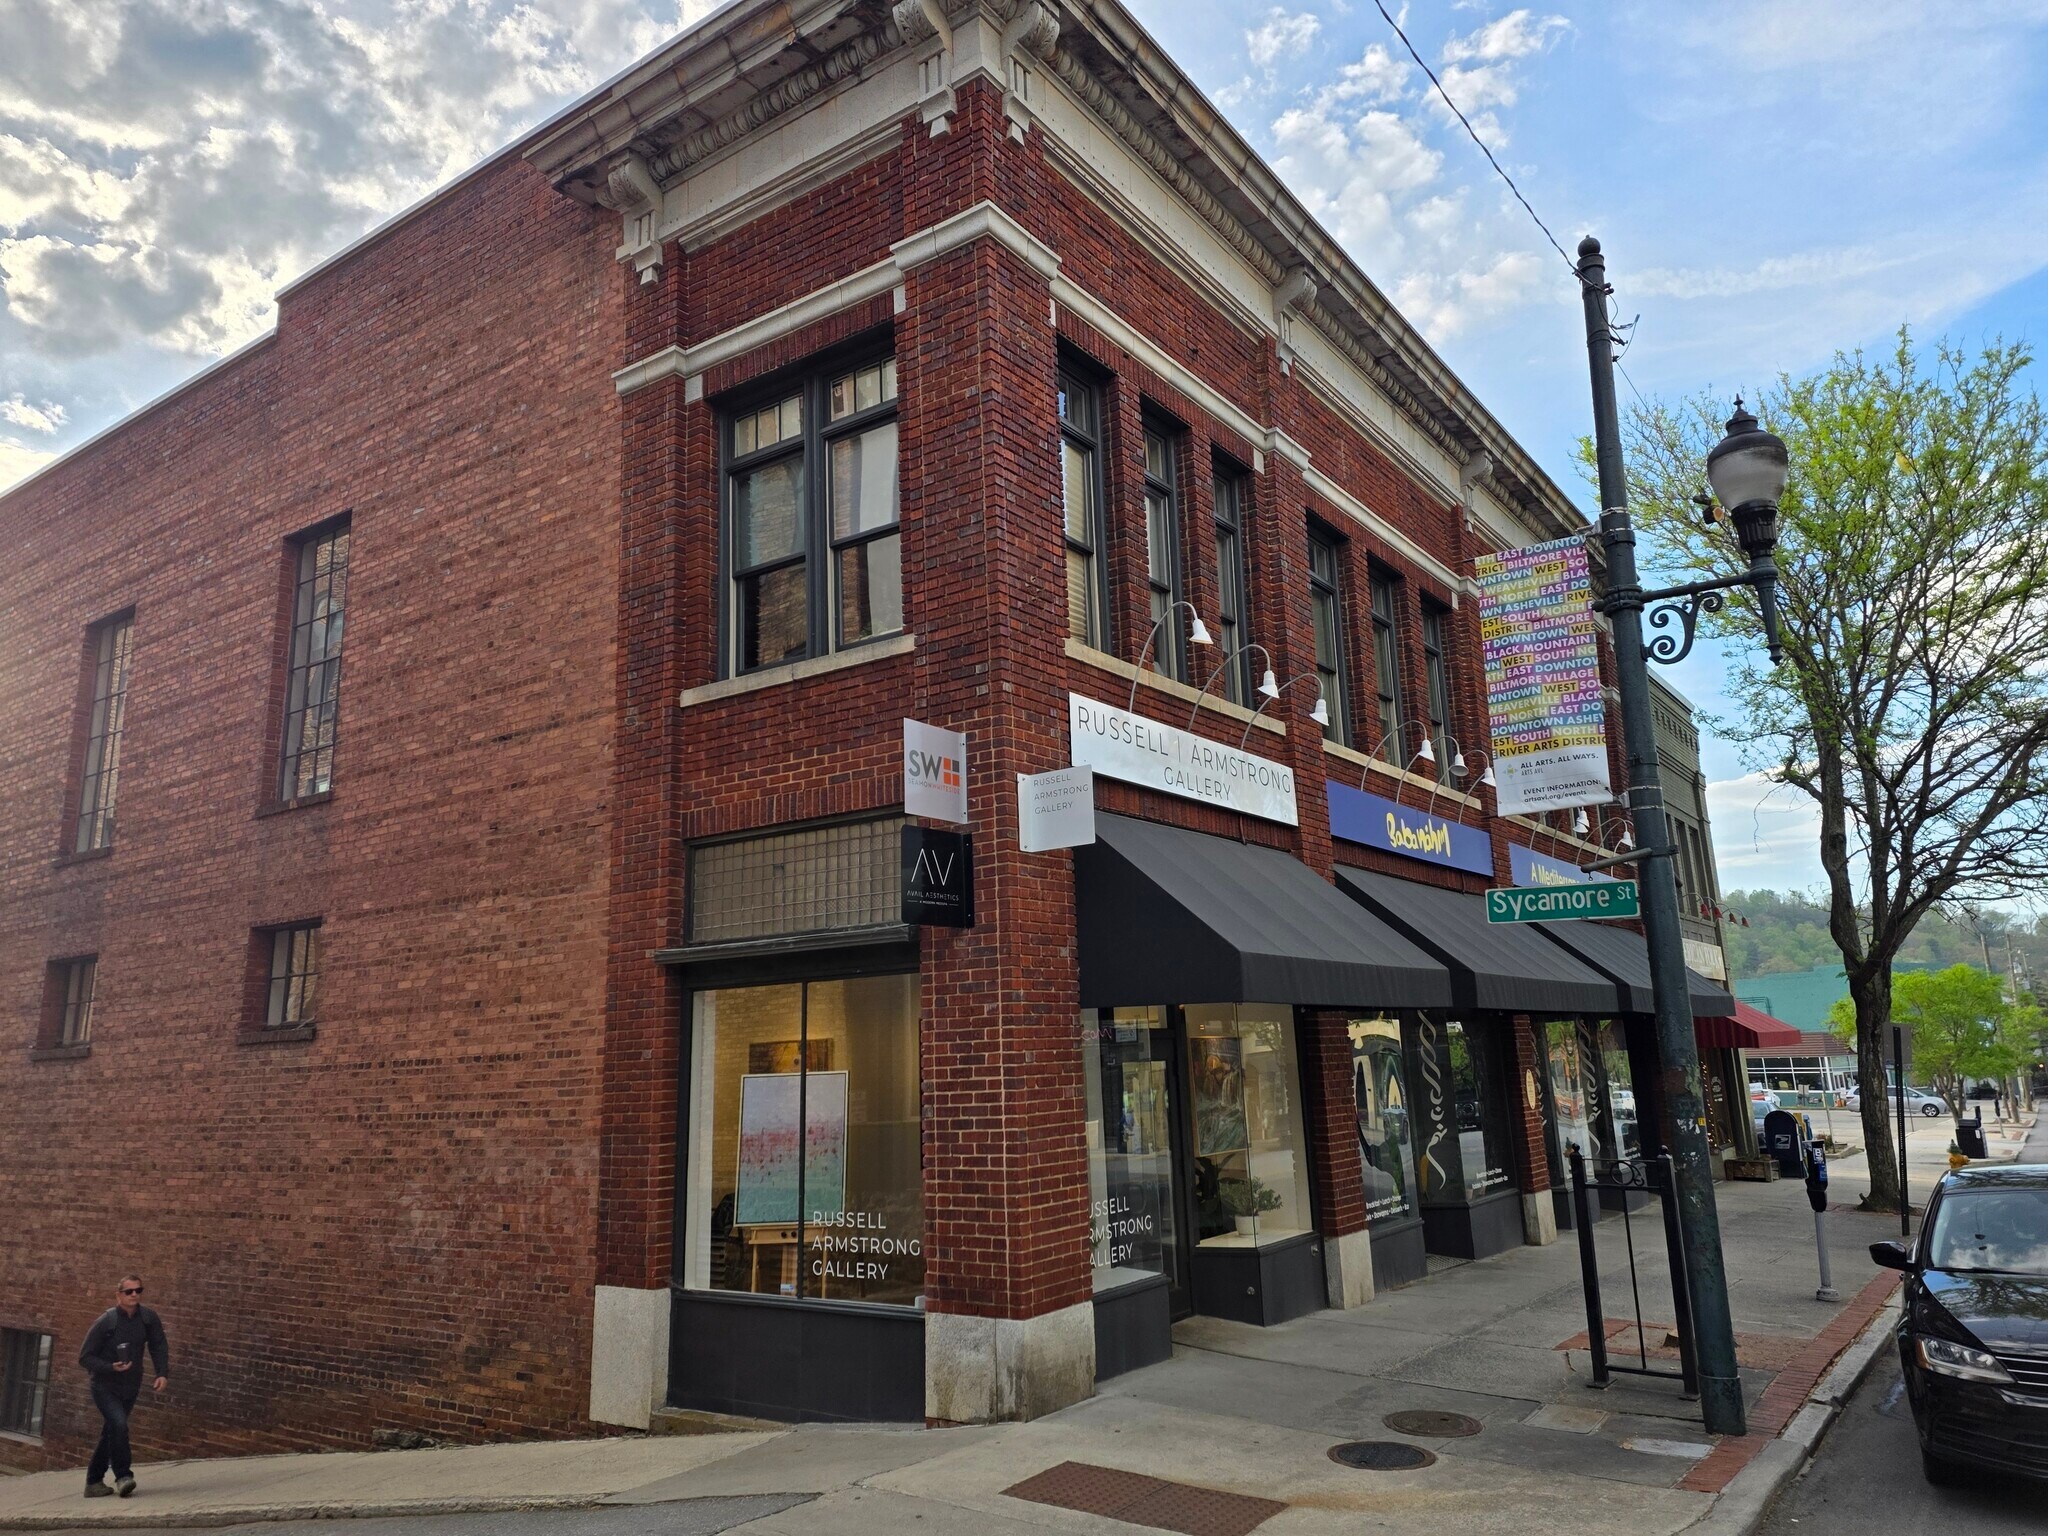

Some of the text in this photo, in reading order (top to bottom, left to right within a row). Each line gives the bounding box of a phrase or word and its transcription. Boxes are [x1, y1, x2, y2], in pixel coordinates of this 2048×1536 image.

[1496, 547, 1522, 561] EAST
[1507, 550, 1561, 570] BILTMORE
[1534, 561, 1566, 574] WEST
[1484, 573, 1560, 596] WEAVERVILLE
[1498, 589, 1538, 603] NORTH
[1540, 582, 1568, 596] EAST
[1571, 578, 1591, 590] DO
[1501, 609, 1540, 624] SOUTH
[1541, 602, 1585, 616] NORTH
[1504, 595, 1564, 612] ASHEVILLE
[1483, 612, 1590, 639] DISTRICT BILTMORE
[1493, 627, 1568, 648] DOWNTOWN
[1486, 635, 1590, 661] BLACK MOUNTAIN
[1502, 655, 1532, 667] WEST
[1534, 648, 1575, 663] SOUTH
[1489, 668, 1594, 693] BILTMORE VILLAGE
[1506, 665, 1532, 678] EAST
[1544, 682, 1577, 694] WEST
[1488, 690, 1602, 715] WEAVERVILLE BLACK
[1508, 706, 1548, 722] NORTH
[1550, 704, 1580, 715] EAST
[1491, 717, 1564, 737] DOWNTOWN
[1513, 729, 1550, 744] SOUTH
[1552, 725, 1597, 737] NORTH
[1078, 706, 1169, 757] RUSSELL
[1191, 744, 1291, 794] ARMSTRONG
[1499, 745, 1530, 757] RIVER
[1533, 740, 1560, 752] ARTS
[908, 749, 943, 782] SW
[1535, 759, 1556, 767] ARTS.
[1558, 755, 1571, 763] ALL
[1572, 752, 1599, 760] WAYS.
[1033, 773, 1071, 787] RUSSELL
[1164, 766, 1231, 801] GALLERY
[1523, 779, 1602, 795] EVENT INFORMATION:
[1034, 783, 1089, 801] ARMSTRONG
[1034, 801, 1073, 815] GALLERY
[1492, 885, 1632, 920] Sycamore St
[1089, 1196, 1130, 1219] USSELL
[812, 1211, 887, 1230] RUSSELL
[1089, 1214, 1152, 1243] RMSTRONG
[811, 1235, 921, 1256] ARMSTRONG
[1089, 1242, 1133, 1268] ALLERY
[812, 1259, 889, 1280] GALLERY
